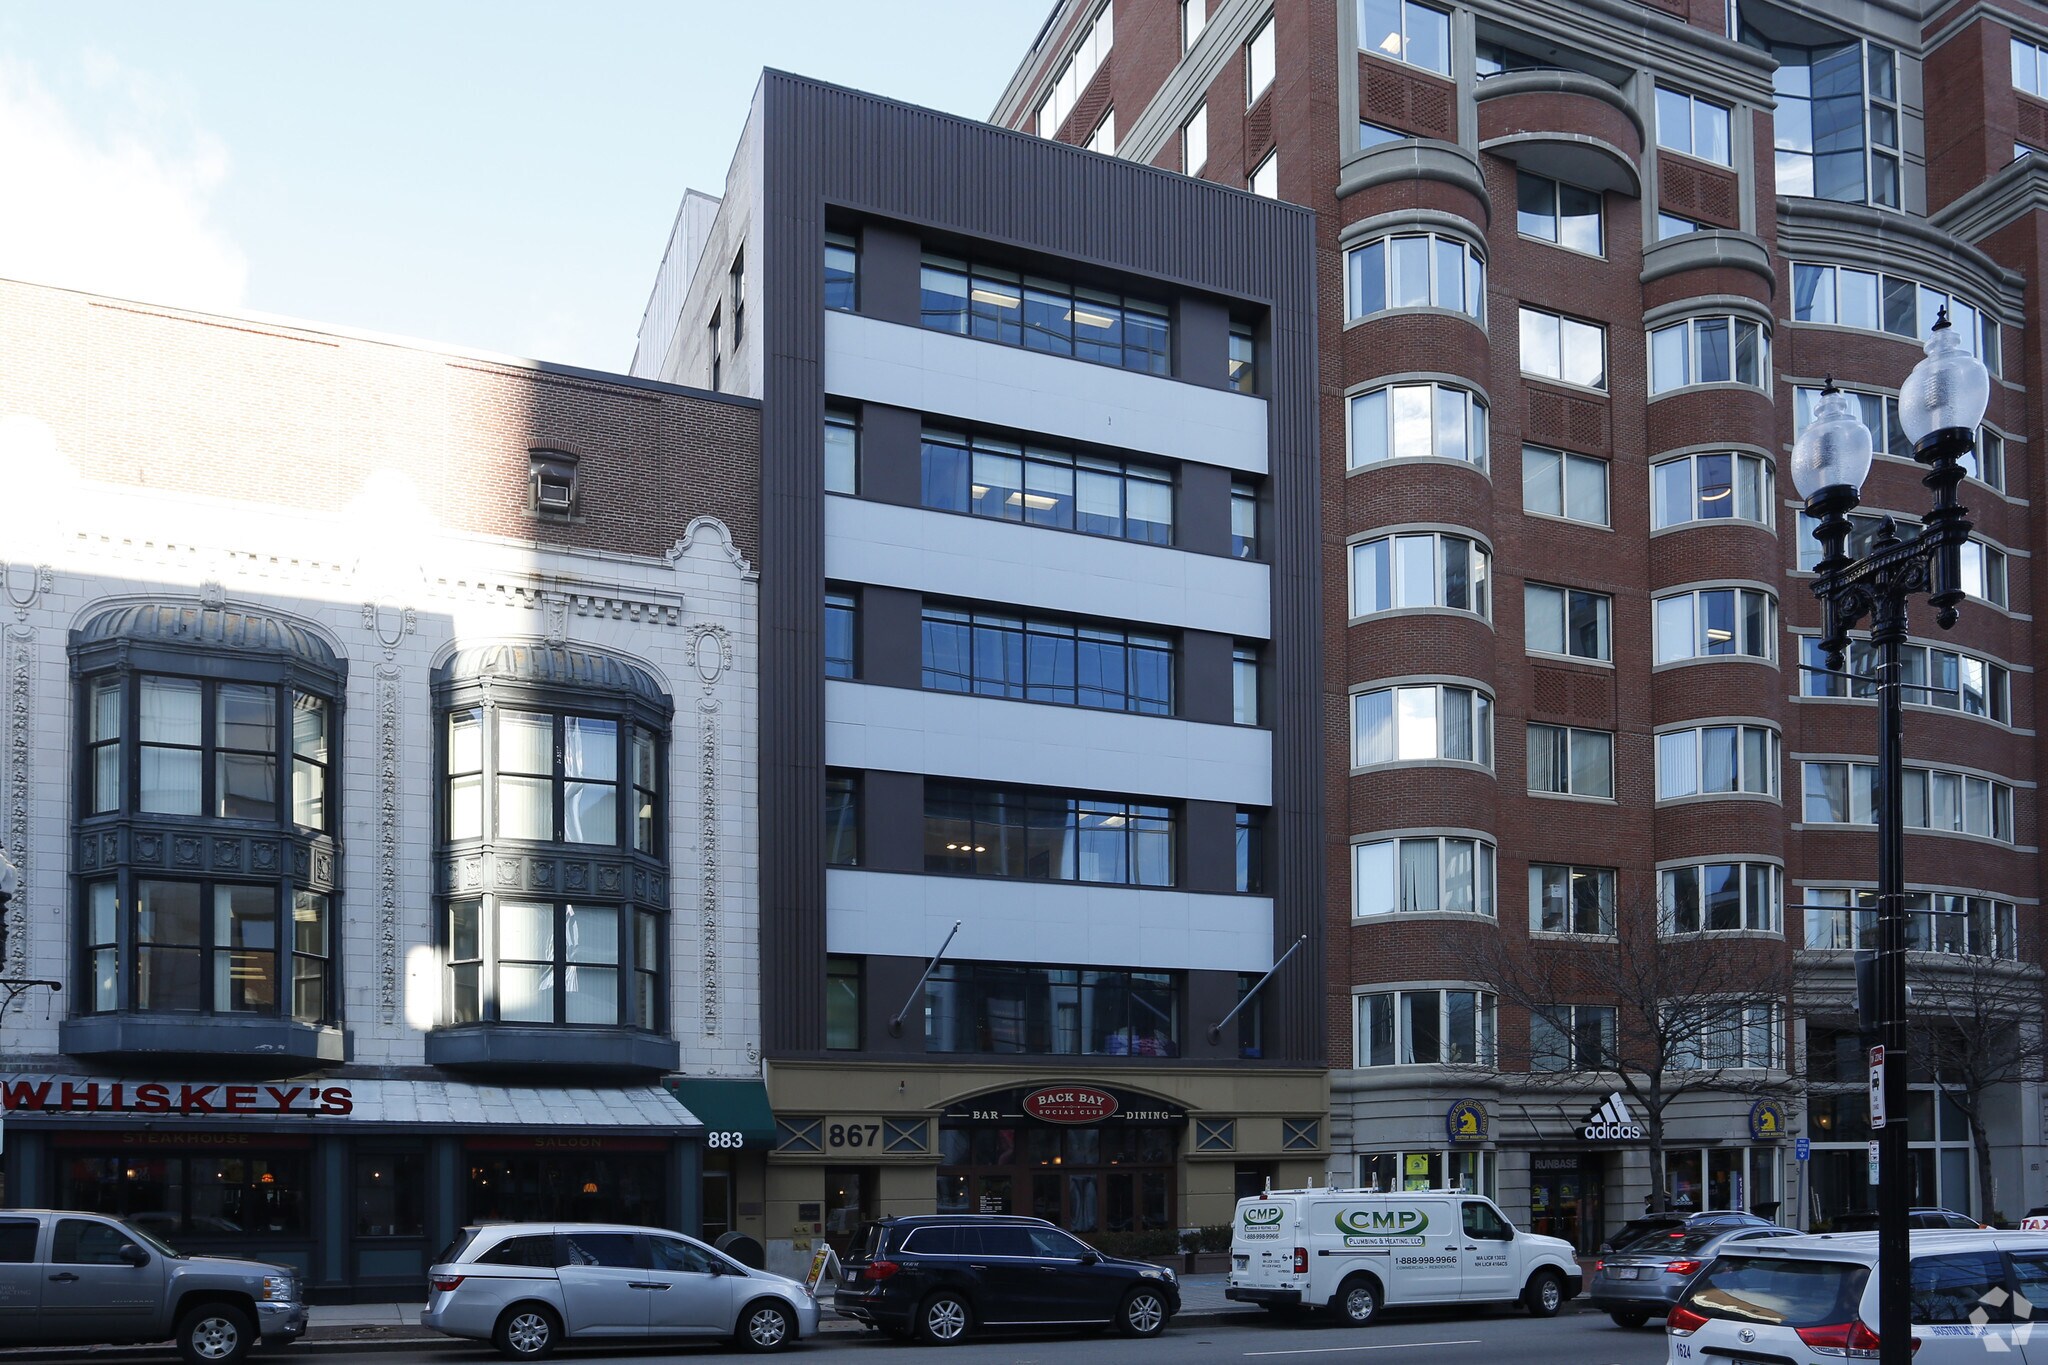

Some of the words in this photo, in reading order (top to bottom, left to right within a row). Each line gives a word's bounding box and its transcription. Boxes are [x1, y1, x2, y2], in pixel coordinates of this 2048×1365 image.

[1, 1080, 353, 1115] WHISKEY'S
[1038, 1093, 1074, 1105] BACK
[1079, 1093, 1105, 1105] BAY
[972, 1111, 999, 1120] BAR
[1126, 1111, 1169, 1120] DINING
[829, 1124, 880, 1148] 867
[1584, 1122, 1640, 1139] adidas
[123, 1132, 249, 1144] STEAKHOUSE
[535, 1137, 601, 1147] SALOON
[708, 1131, 744, 1148] 883
[1535, 1159, 1577, 1169] RUNBASE
[1248, 1208, 1278, 1220] CMP
[1350, 1211, 1417, 1229] CMP
[1395, 1256, 1457, 1264] 1-888-998-9966
[1931, 1326, 1962, 1336] BOSTON
[1676, 1342, 1691, 1359] 1624
